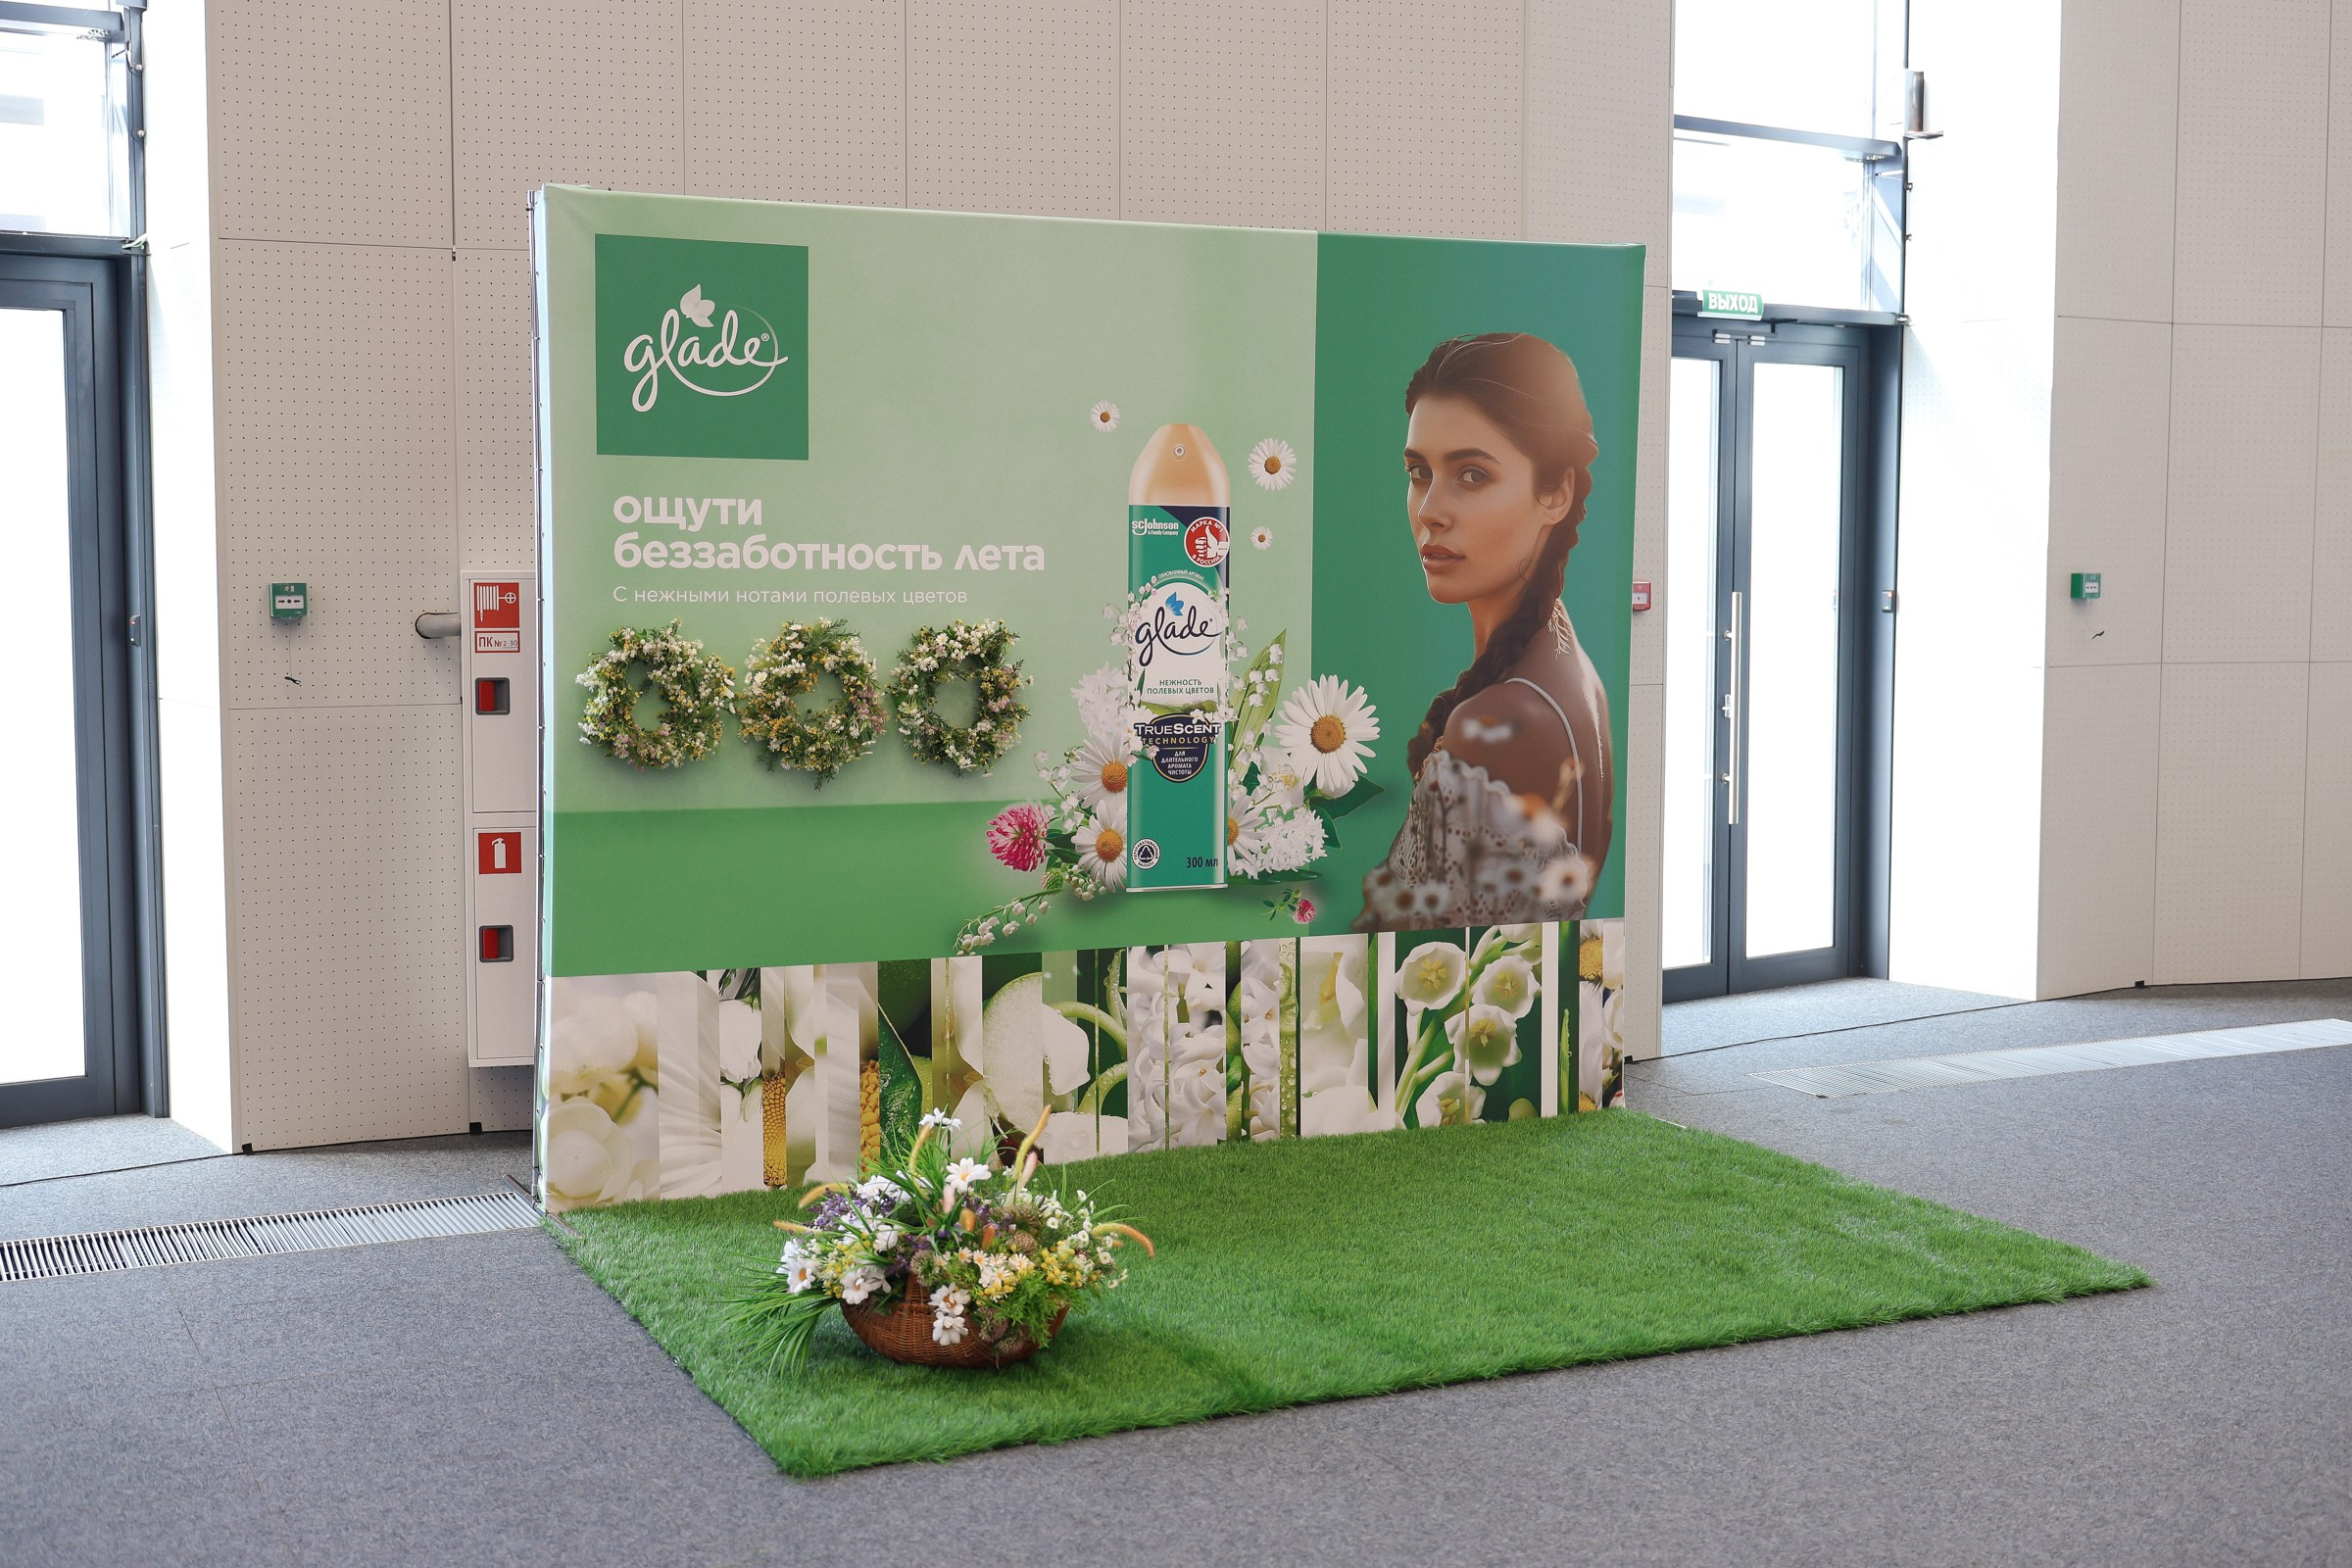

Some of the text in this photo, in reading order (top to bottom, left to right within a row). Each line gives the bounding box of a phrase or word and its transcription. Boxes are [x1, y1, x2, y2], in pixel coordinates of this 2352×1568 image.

[1708, 292, 1758, 314] ВЫХОД
[613, 494, 762, 532] ощути
[1191, 519, 1212, 533] МАРКА
[613, 533, 1045, 571] беззаботность лета
[1196, 556, 1221, 565] РОССИИ
[612, 586, 967, 605] С нежными нотами полевых цветов
[478, 636, 493, 648] ПК
[1142, 736, 1215, 745] TECHNOLOGY
[1186, 857, 1218, 868] 300 мл
